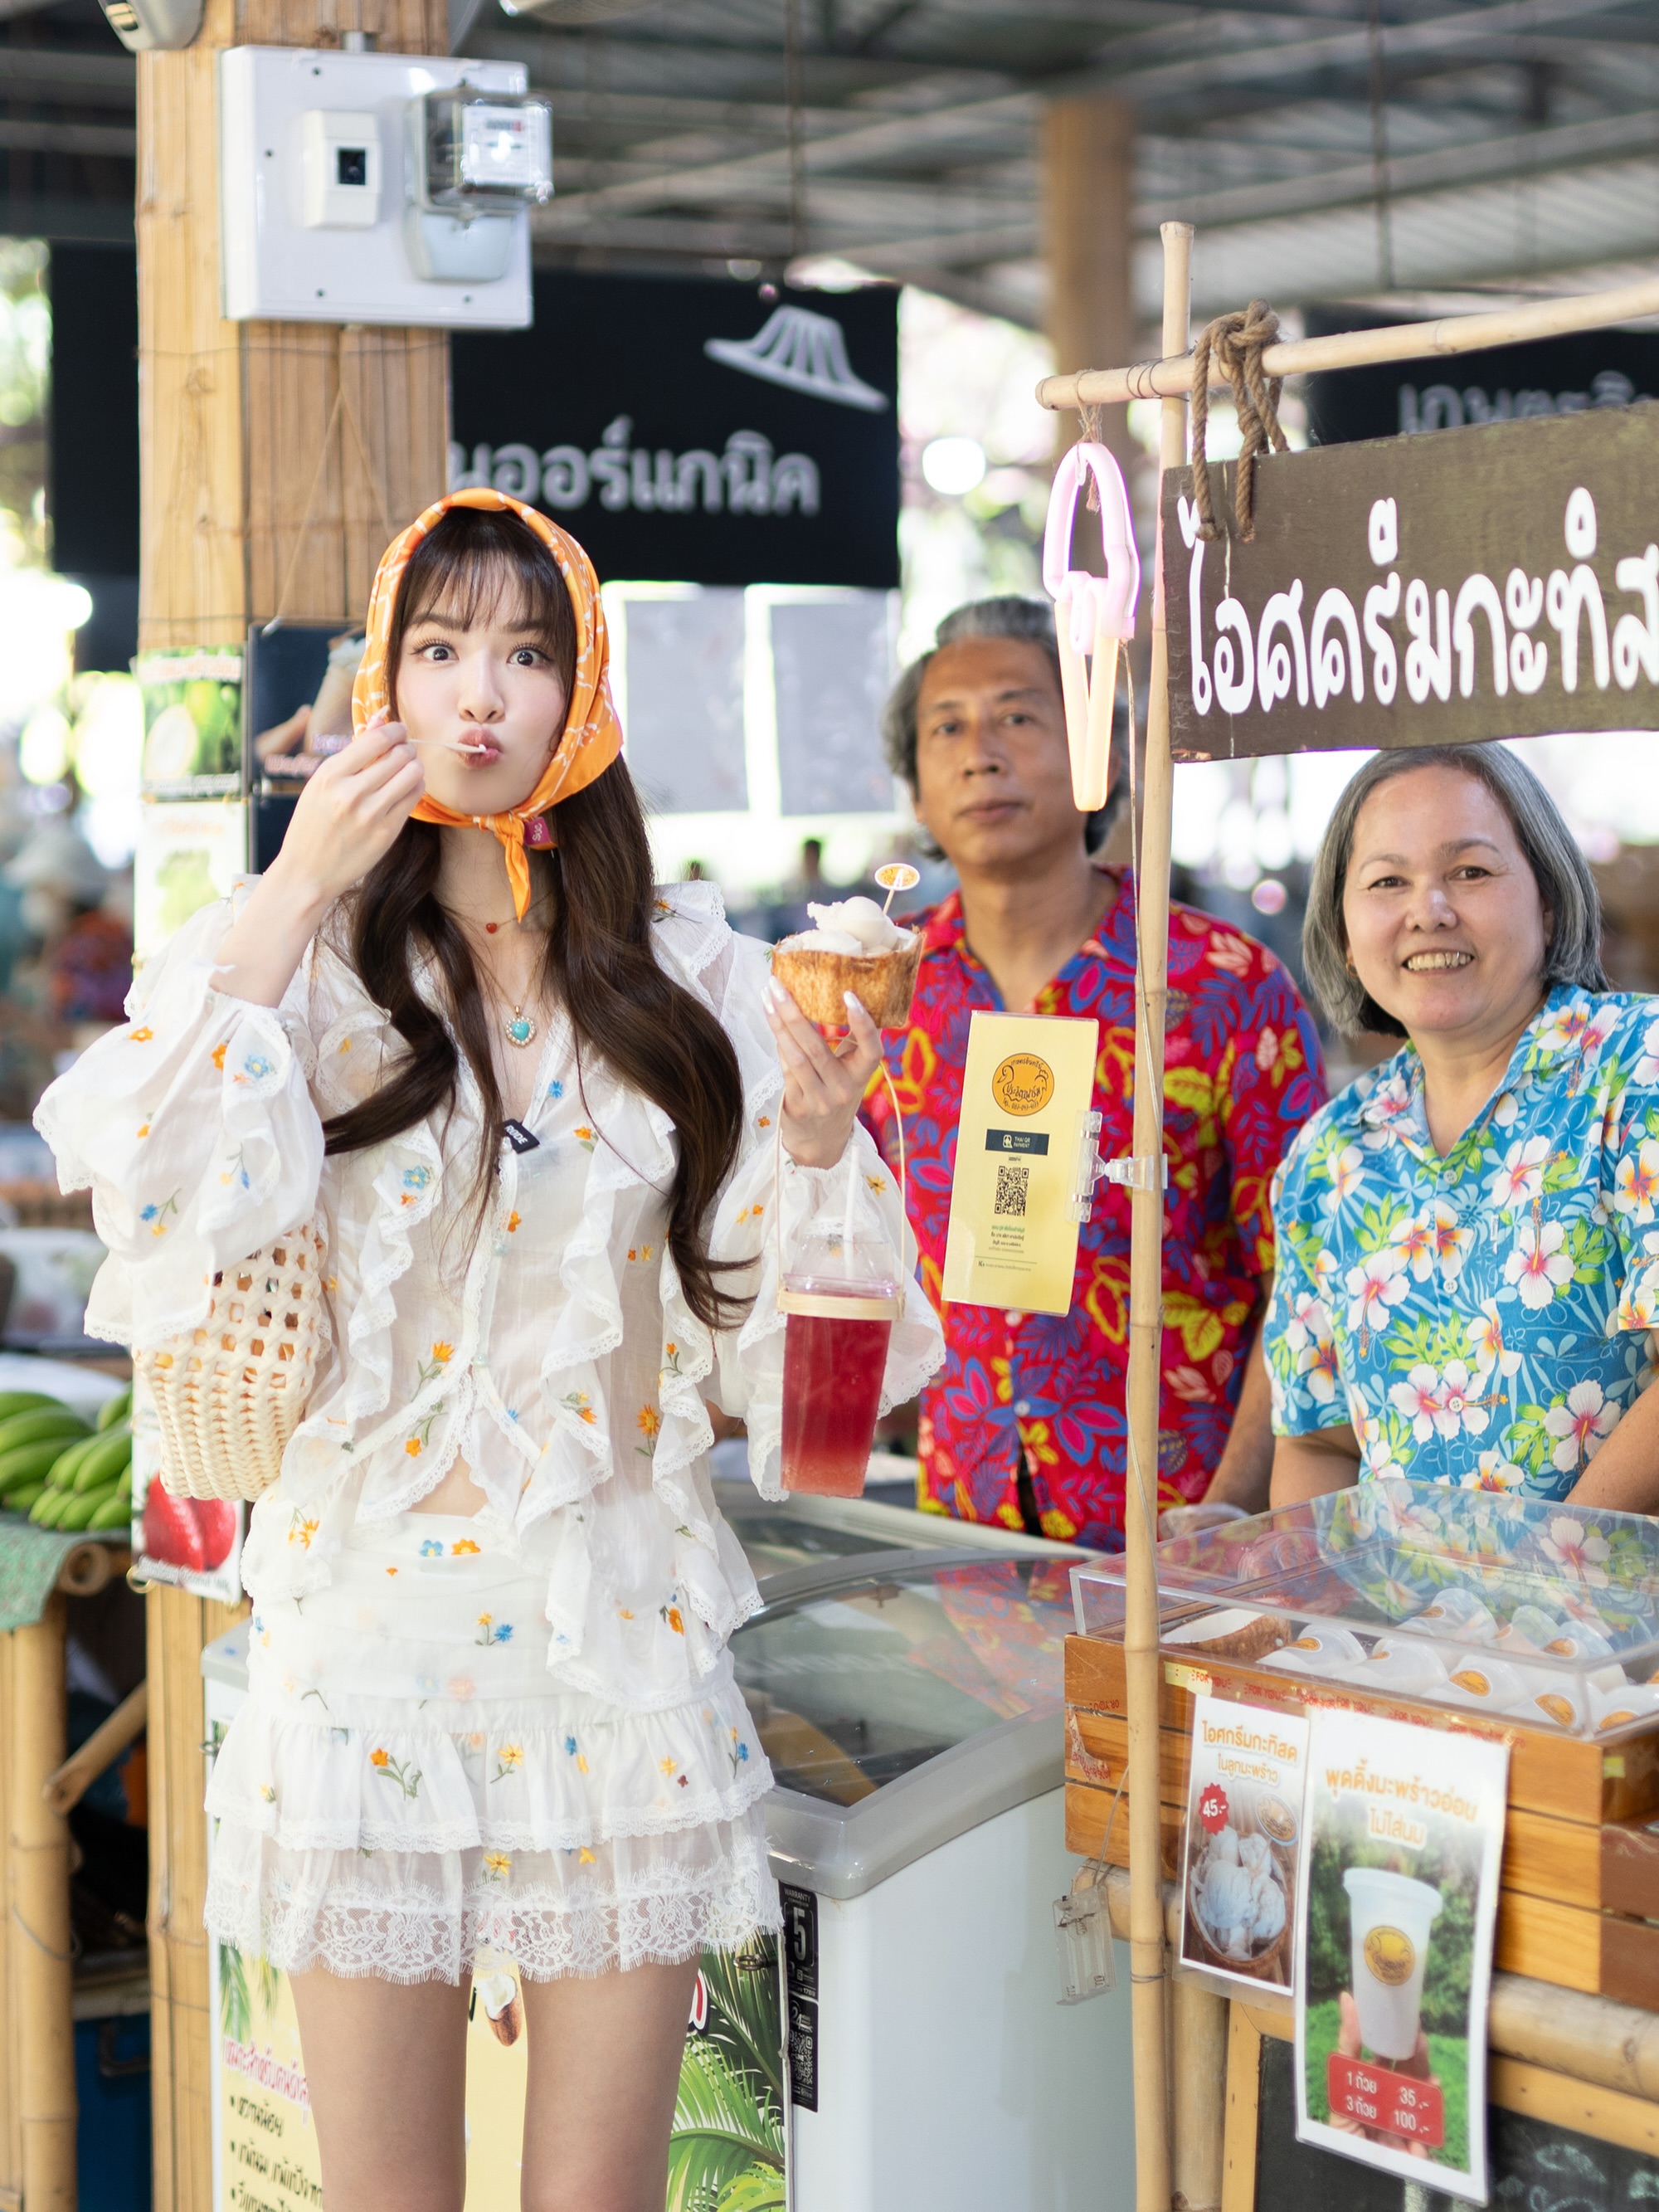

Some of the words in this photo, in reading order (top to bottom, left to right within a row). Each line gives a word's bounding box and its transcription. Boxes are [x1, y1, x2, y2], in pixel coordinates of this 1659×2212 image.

[1195, 1671, 1209, 1683] FOR
[1248, 1684, 1262, 1696] FOR
[1202, 1720, 1298, 1762] ไอศกรีมกะทิสด
[793, 1907, 806, 1961] 5
[1347, 2071, 1353, 2086] 1
[1346, 2095, 1354, 2111] 3
